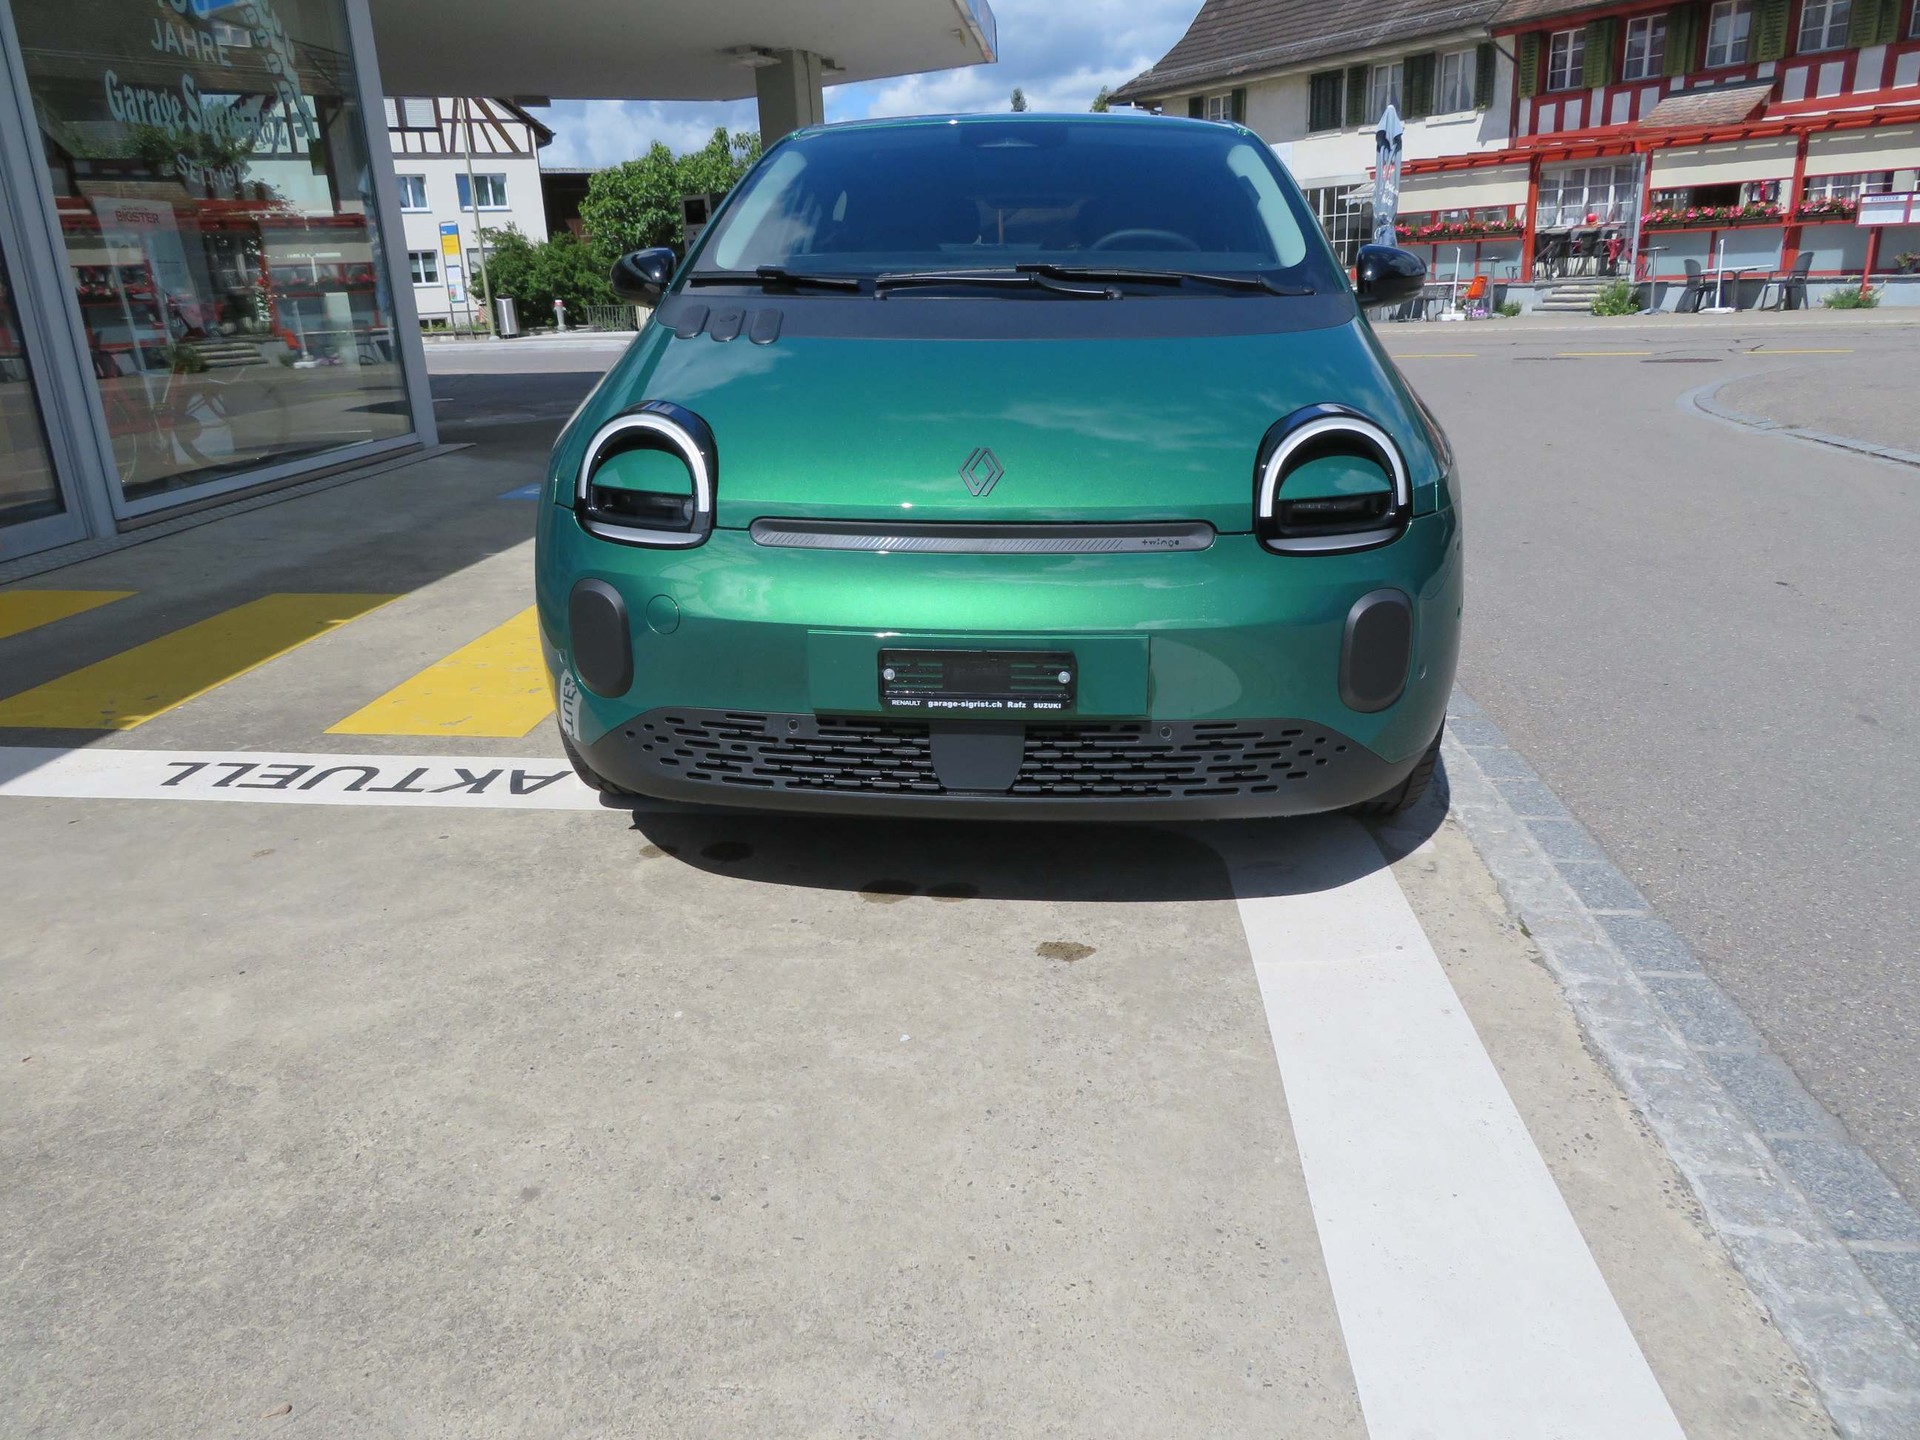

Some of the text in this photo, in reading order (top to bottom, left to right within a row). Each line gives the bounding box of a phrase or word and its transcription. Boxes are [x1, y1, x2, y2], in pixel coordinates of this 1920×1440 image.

[151, 18, 233, 68] JAHRE
[104, 69, 185, 141] Garage
[115, 210, 160, 224] BIGSTER
[927, 700, 1002, 709] garage-sigrist.ch
[1007, 701, 1026, 709] Rafz
[160, 761, 575, 796] AKTUELL
